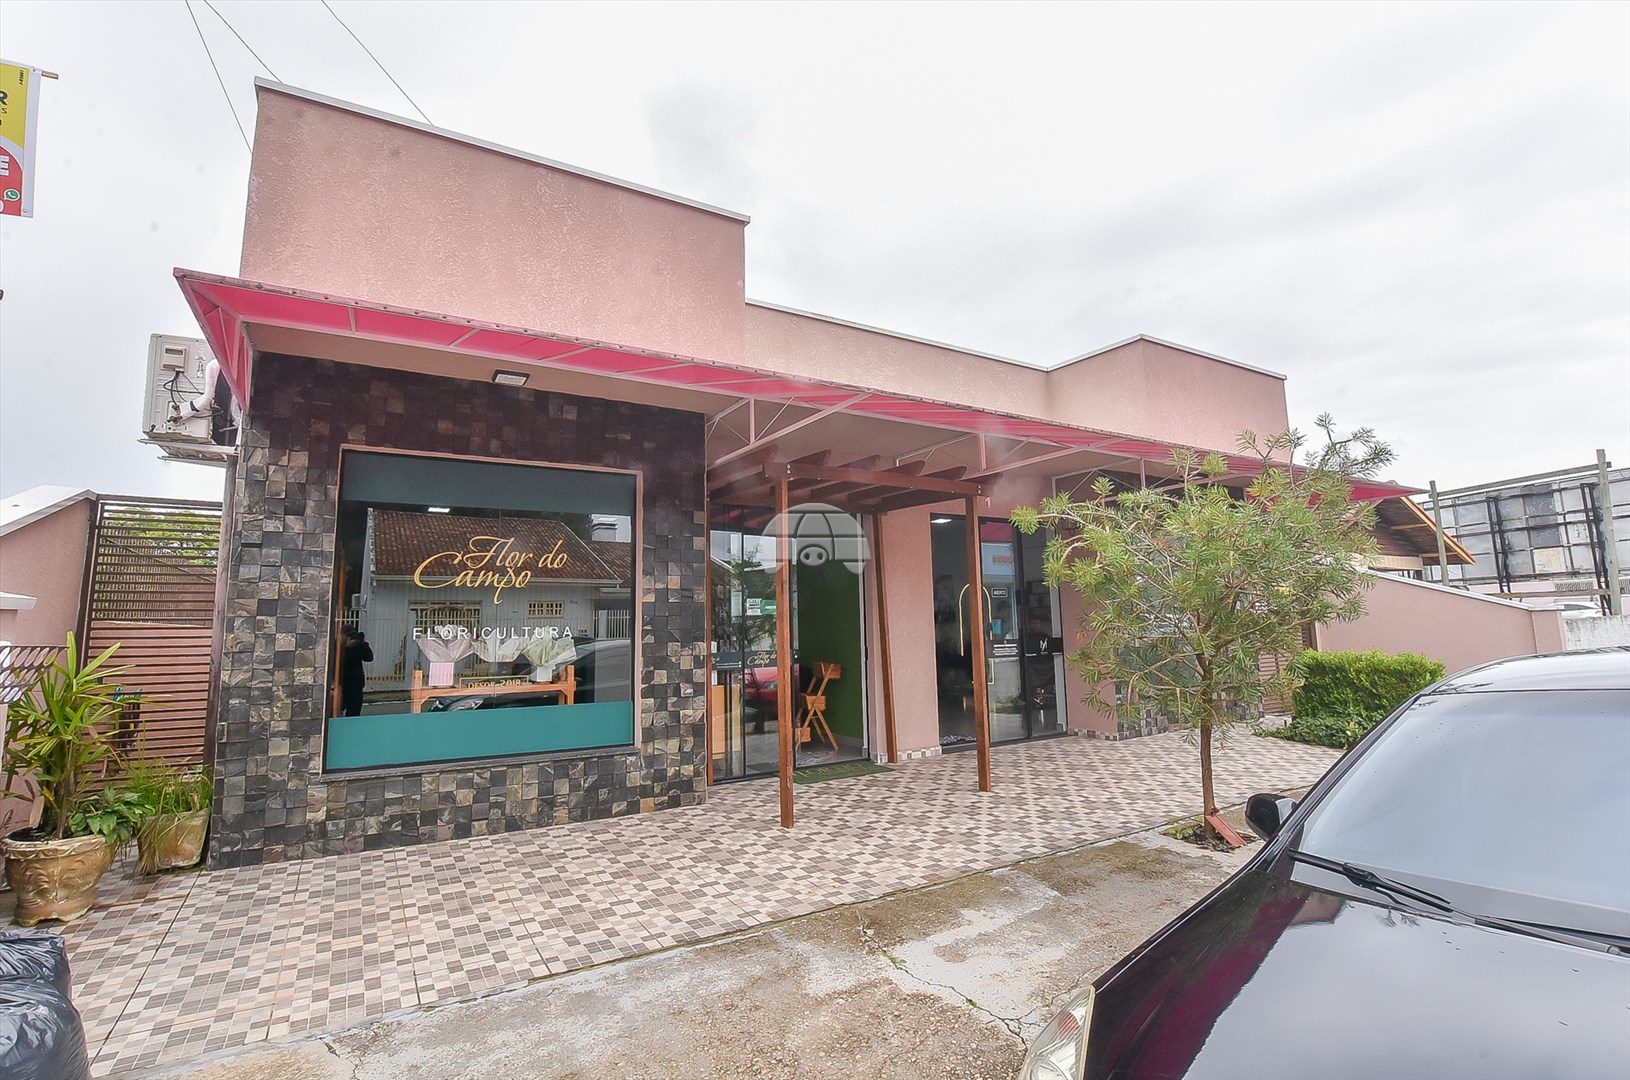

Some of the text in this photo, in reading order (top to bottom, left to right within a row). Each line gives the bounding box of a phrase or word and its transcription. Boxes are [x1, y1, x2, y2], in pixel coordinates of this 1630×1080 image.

[463, 535, 568, 568] Flor do
[413, 551, 532, 605] Campo
[412, 626, 573, 640] FLORICULTURA
